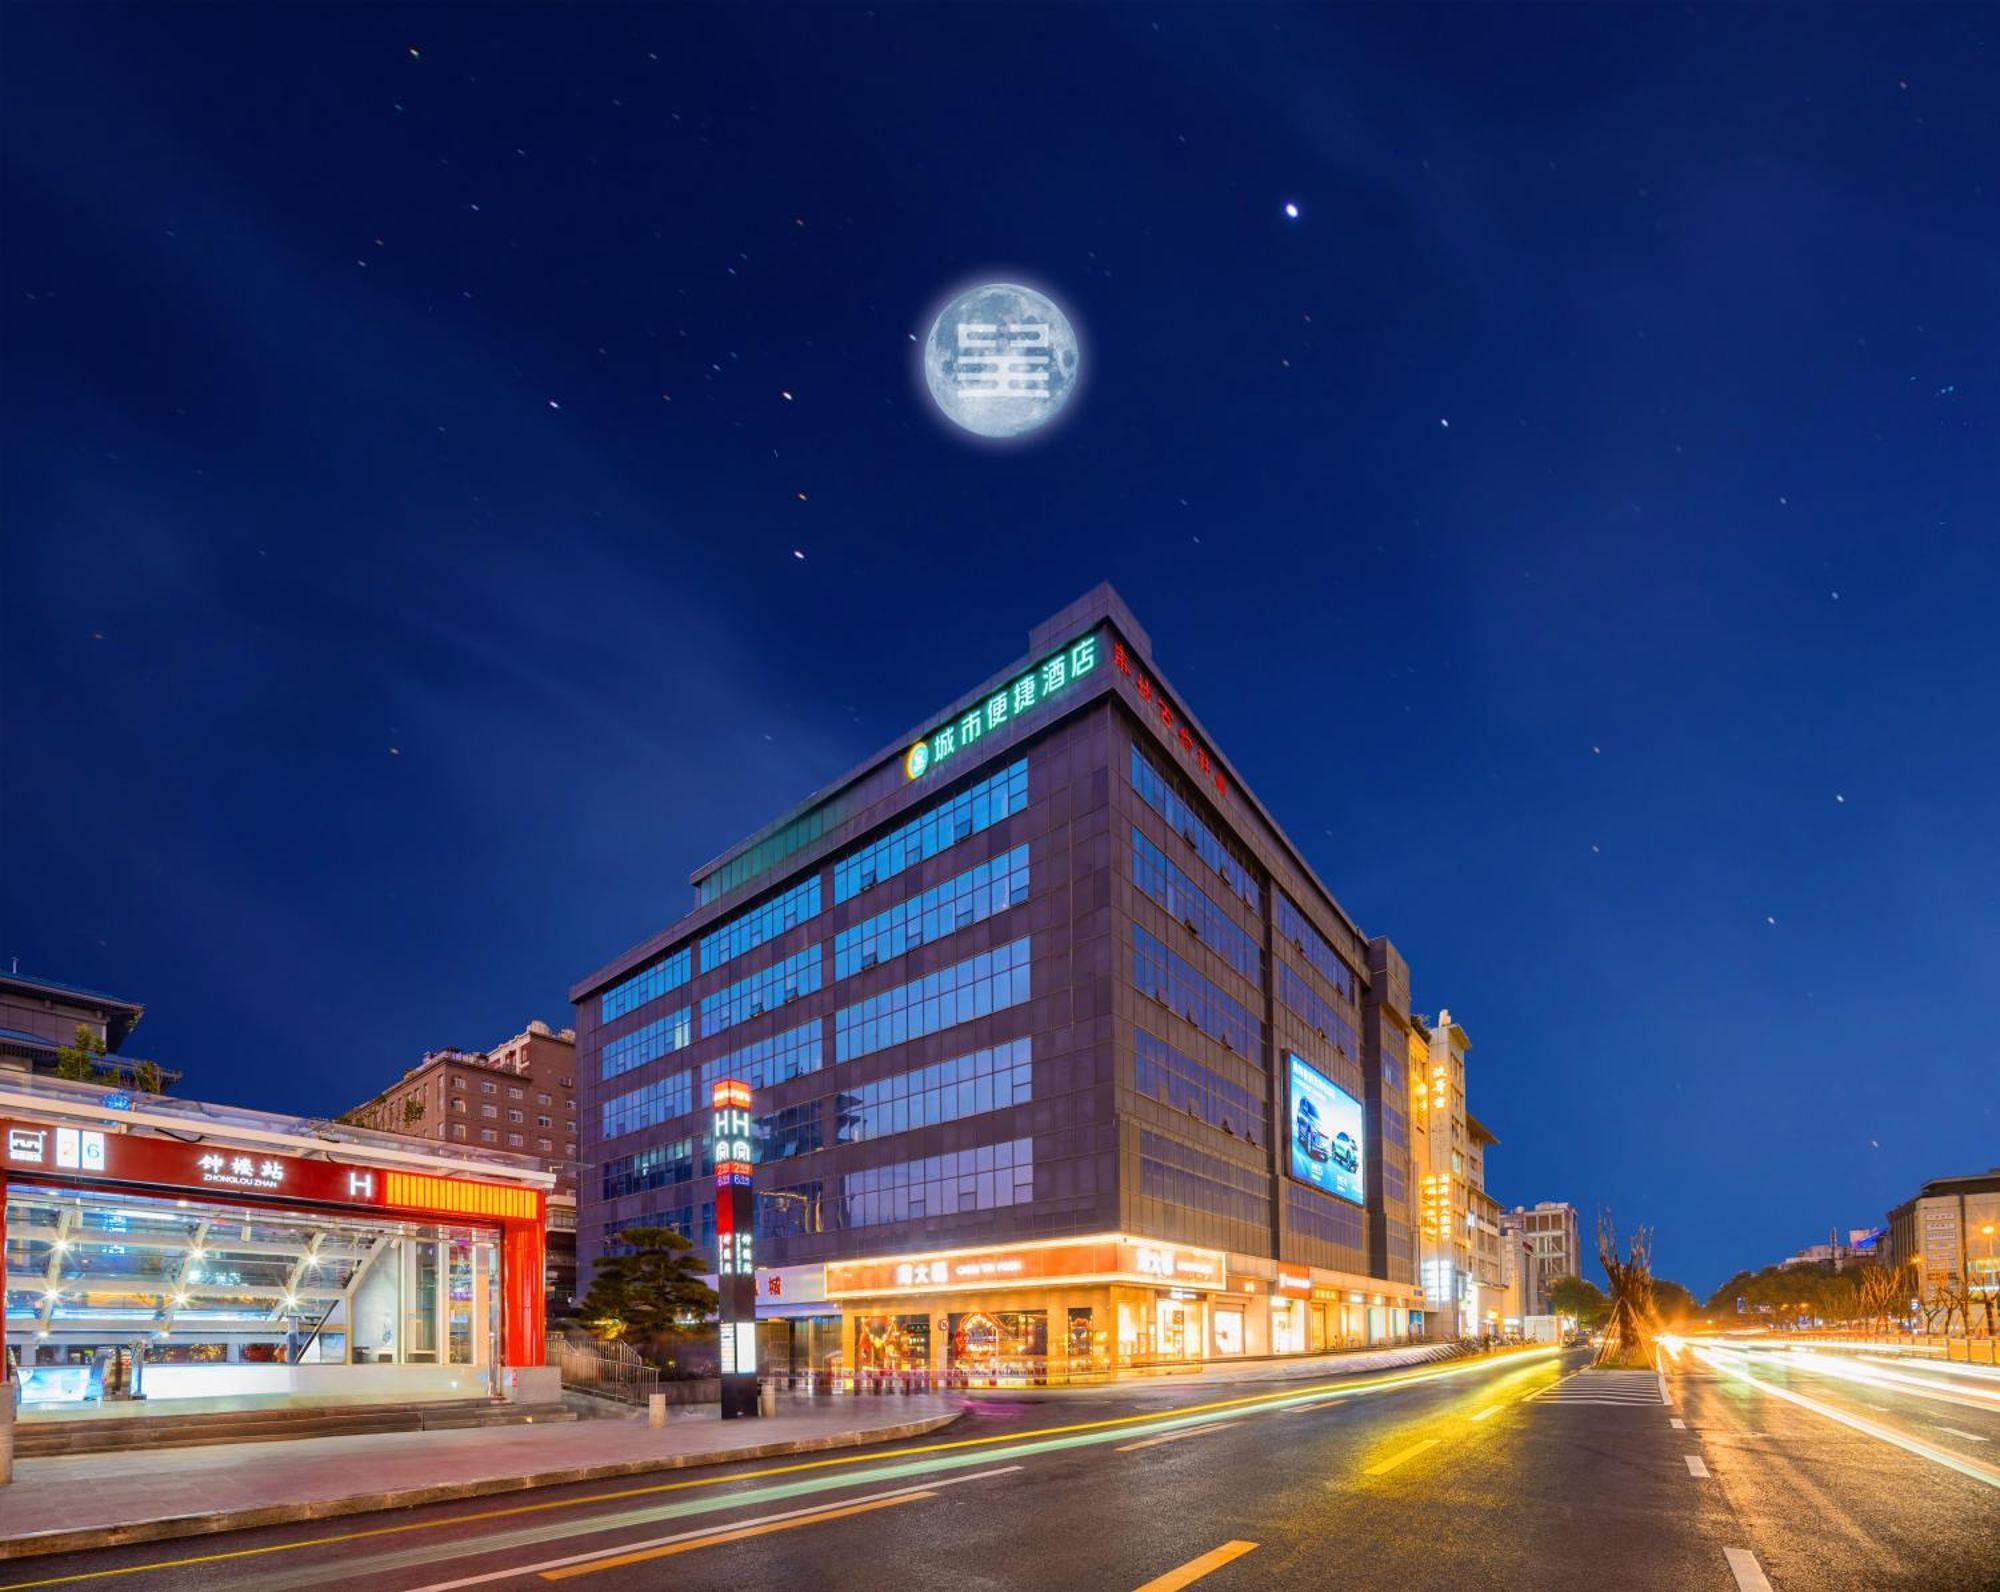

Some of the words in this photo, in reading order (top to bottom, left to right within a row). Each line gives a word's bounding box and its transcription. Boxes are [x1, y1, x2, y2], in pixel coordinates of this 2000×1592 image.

[933, 637, 1095, 763] 城市便捷酒店
[732, 1109, 749, 1137] H
[350, 1172, 372, 1197] H
